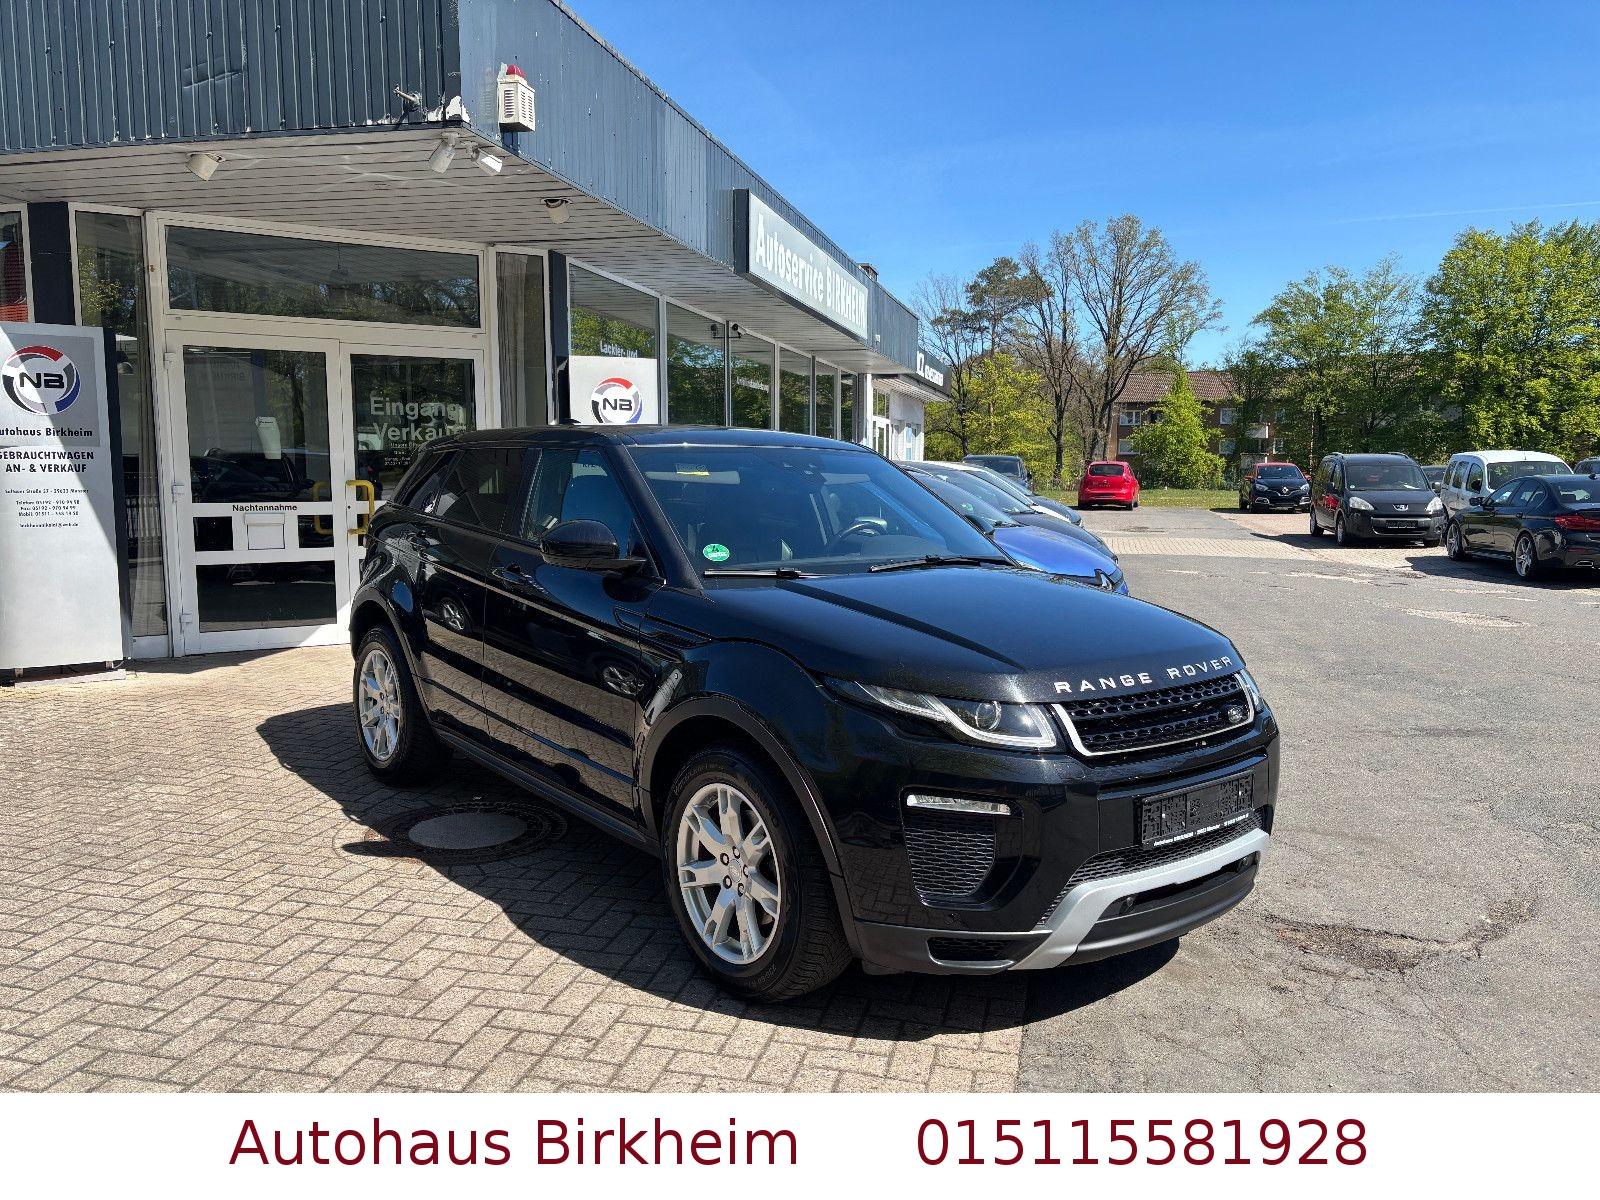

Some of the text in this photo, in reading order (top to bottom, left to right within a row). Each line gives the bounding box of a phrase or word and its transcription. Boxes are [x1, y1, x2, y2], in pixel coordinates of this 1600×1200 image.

[755, 212, 866, 330] Autoservice BIRKHEIM
[19, 371, 65, 389] NB
[371, 396, 464, 422] Eingang
[602, 397, 633, 412] NB
[0, 427, 93, 437] utohaus Birkheim
[6, 463, 87, 473] AN- & VERKAUF
[232, 503, 298, 512] Nachtannahme
[1053, 655, 1233, 694] RANGE ROVER
